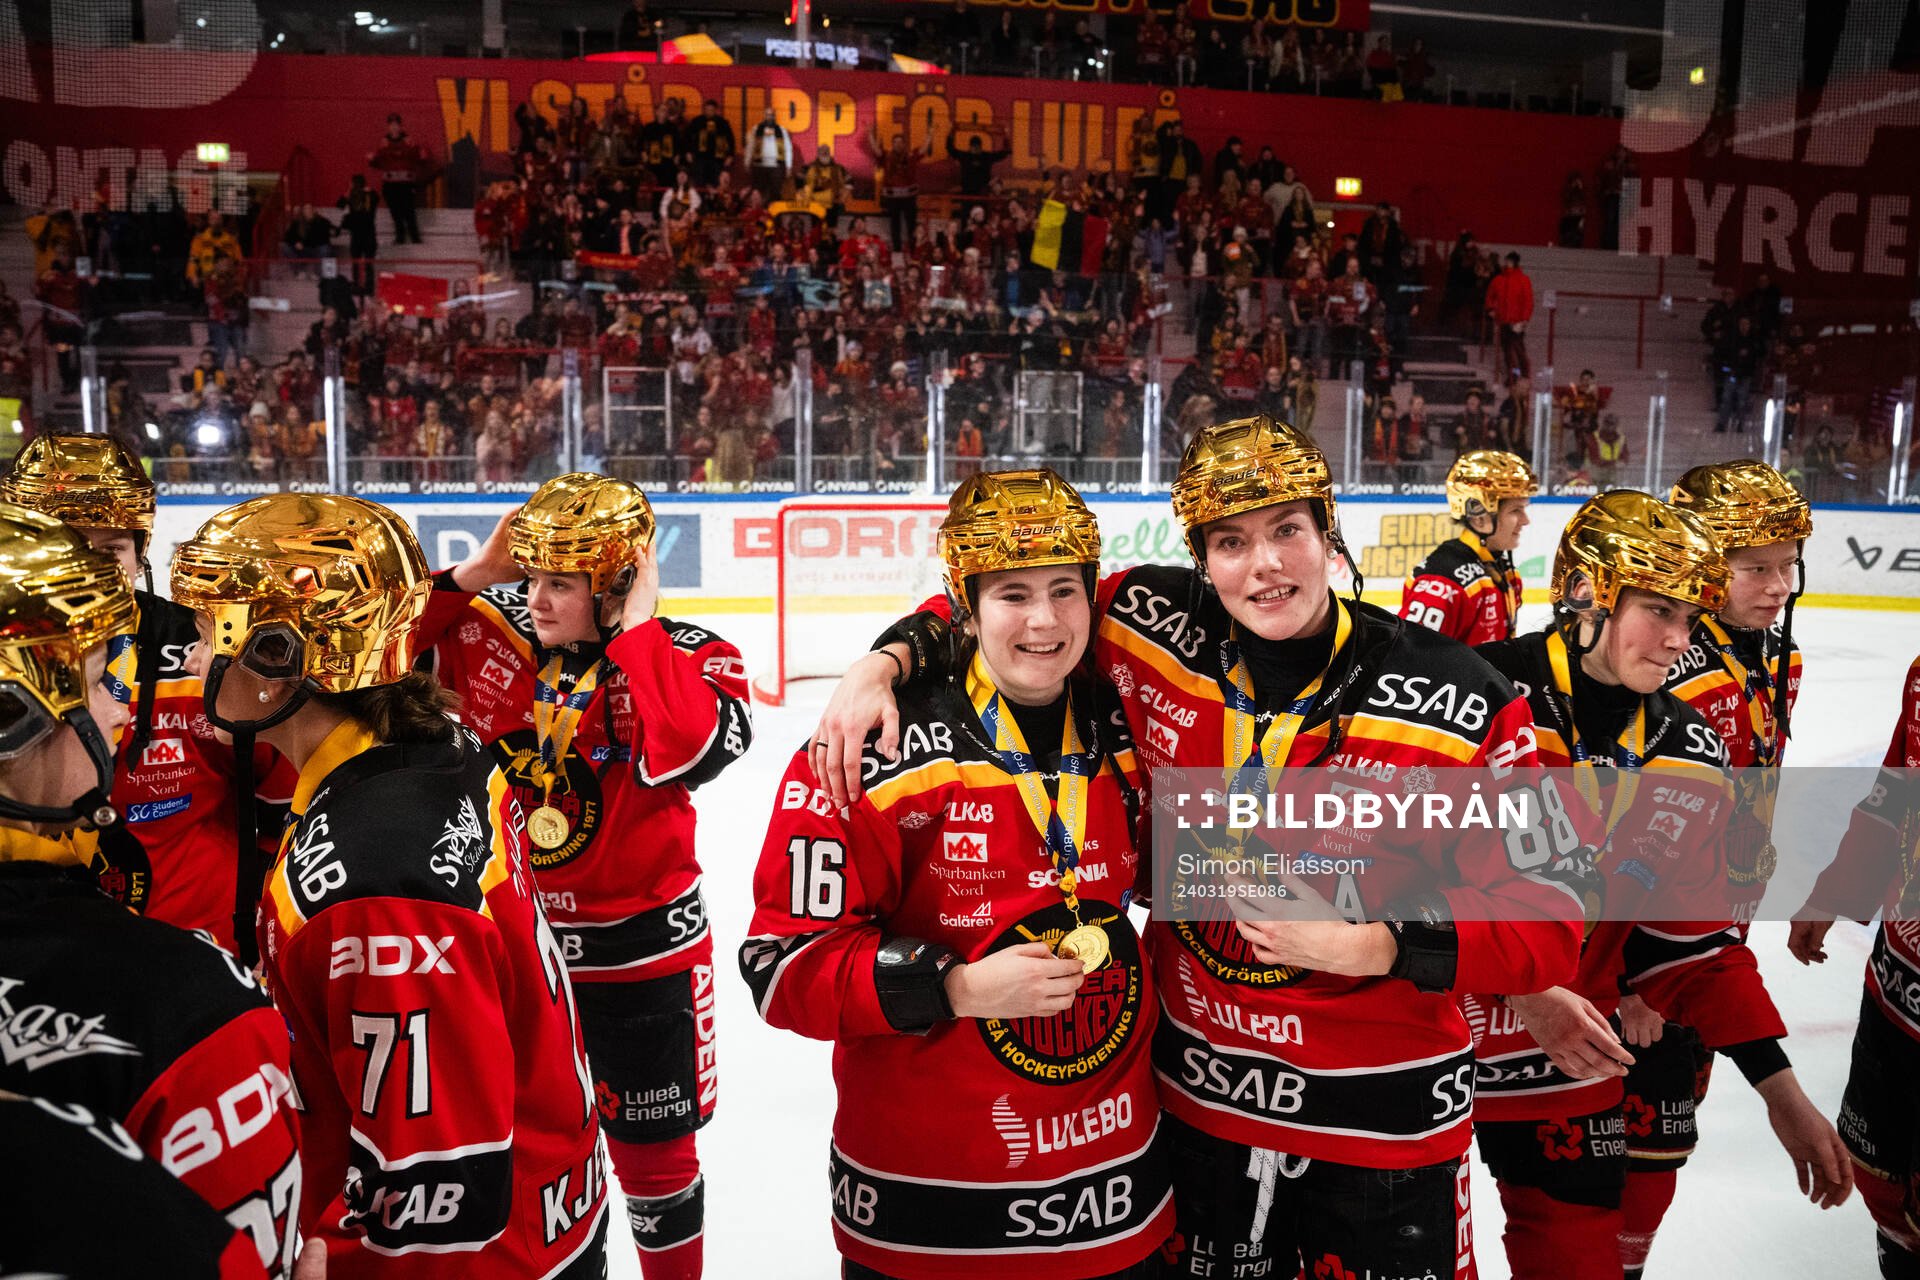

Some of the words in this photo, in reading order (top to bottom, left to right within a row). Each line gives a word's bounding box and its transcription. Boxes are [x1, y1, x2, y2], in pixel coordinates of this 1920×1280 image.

[436, 78, 510, 153] VI
[170, 483, 216, 494] NYAB
[236, 483, 280, 494] NYAB
[366, 482, 410, 493] NYAB
[433, 482, 478, 493] NYAB
[692, 481, 733, 492] NYAB
[752, 481, 795, 492] NYAB
[827, 481, 870, 492] NYAB
[1358, 484, 1394, 494] NYAB
[1563, 485, 1598, 495] NYAB
[1010, 525, 1063, 537] BAUER
[1113, 584, 1207, 659] SSAB
[1151, 692, 1198, 728] LKAB
[1367, 673, 1489, 732] SSAB
[126, 766, 197, 787] Sparbanken
[1341, 754, 1397, 784] LKAB
[148, 782, 181, 797] Nord
[583, 800, 597, 829] 1977
[948, 801, 995, 824] LKAB
[1502, 773, 1581, 873] 88
[293, 812, 348, 903] SSAB
[946, 834, 985, 861] MAX
[786, 835, 847, 922] 16
[928, 861, 1006, 882] Sparbanken
[1028, 862, 1110, 889] SCNIA
[947, 882, 985, 898] Nord
[939, 910, 995, 928] Galären
[329, 935, 457, 980] BDX
[1000, 1008, 1133, 1080] HOCKEYFÖRENING
[1127, 964, 1138, 1004] 1977
[1201, 995, 1304, 1046] LULEBO
[350, 1008, 433, 1120] 71
[625, 1081, 682, 1105] Luleå
[1181, 1047, 1307, 1114] SSAB
[625, 1098, 692, 1122] Energi
[1036, 1092, 1133, 1154] LULEBO
[1005, 1174, 1133, 1238] SSAB
